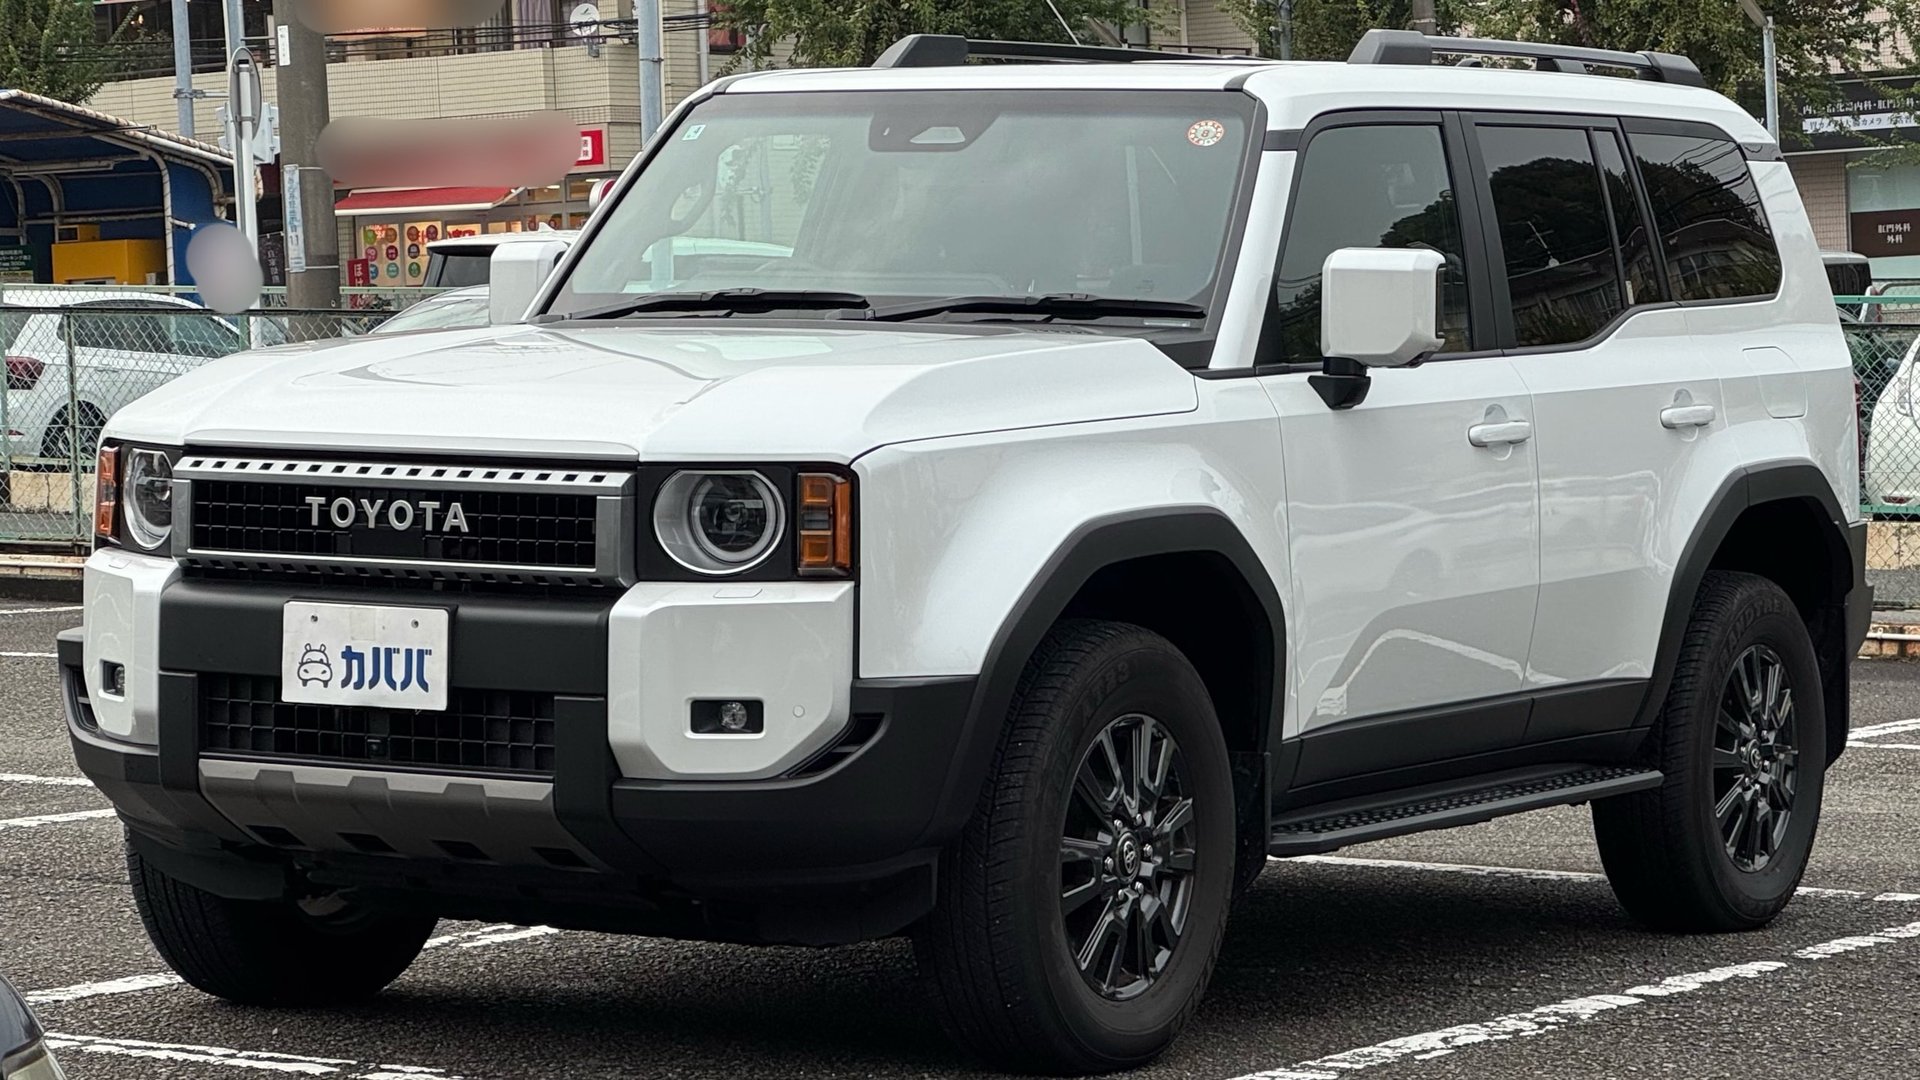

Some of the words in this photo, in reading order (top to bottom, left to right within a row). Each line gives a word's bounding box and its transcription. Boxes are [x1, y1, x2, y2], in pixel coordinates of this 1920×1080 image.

[1877, 222, 1911, 234] 肛門外科
[1886, 234, 1903, 244] 外科
[305, 495, 470, 534] TOYOTA
[340, 645, 433, 693] カババ
